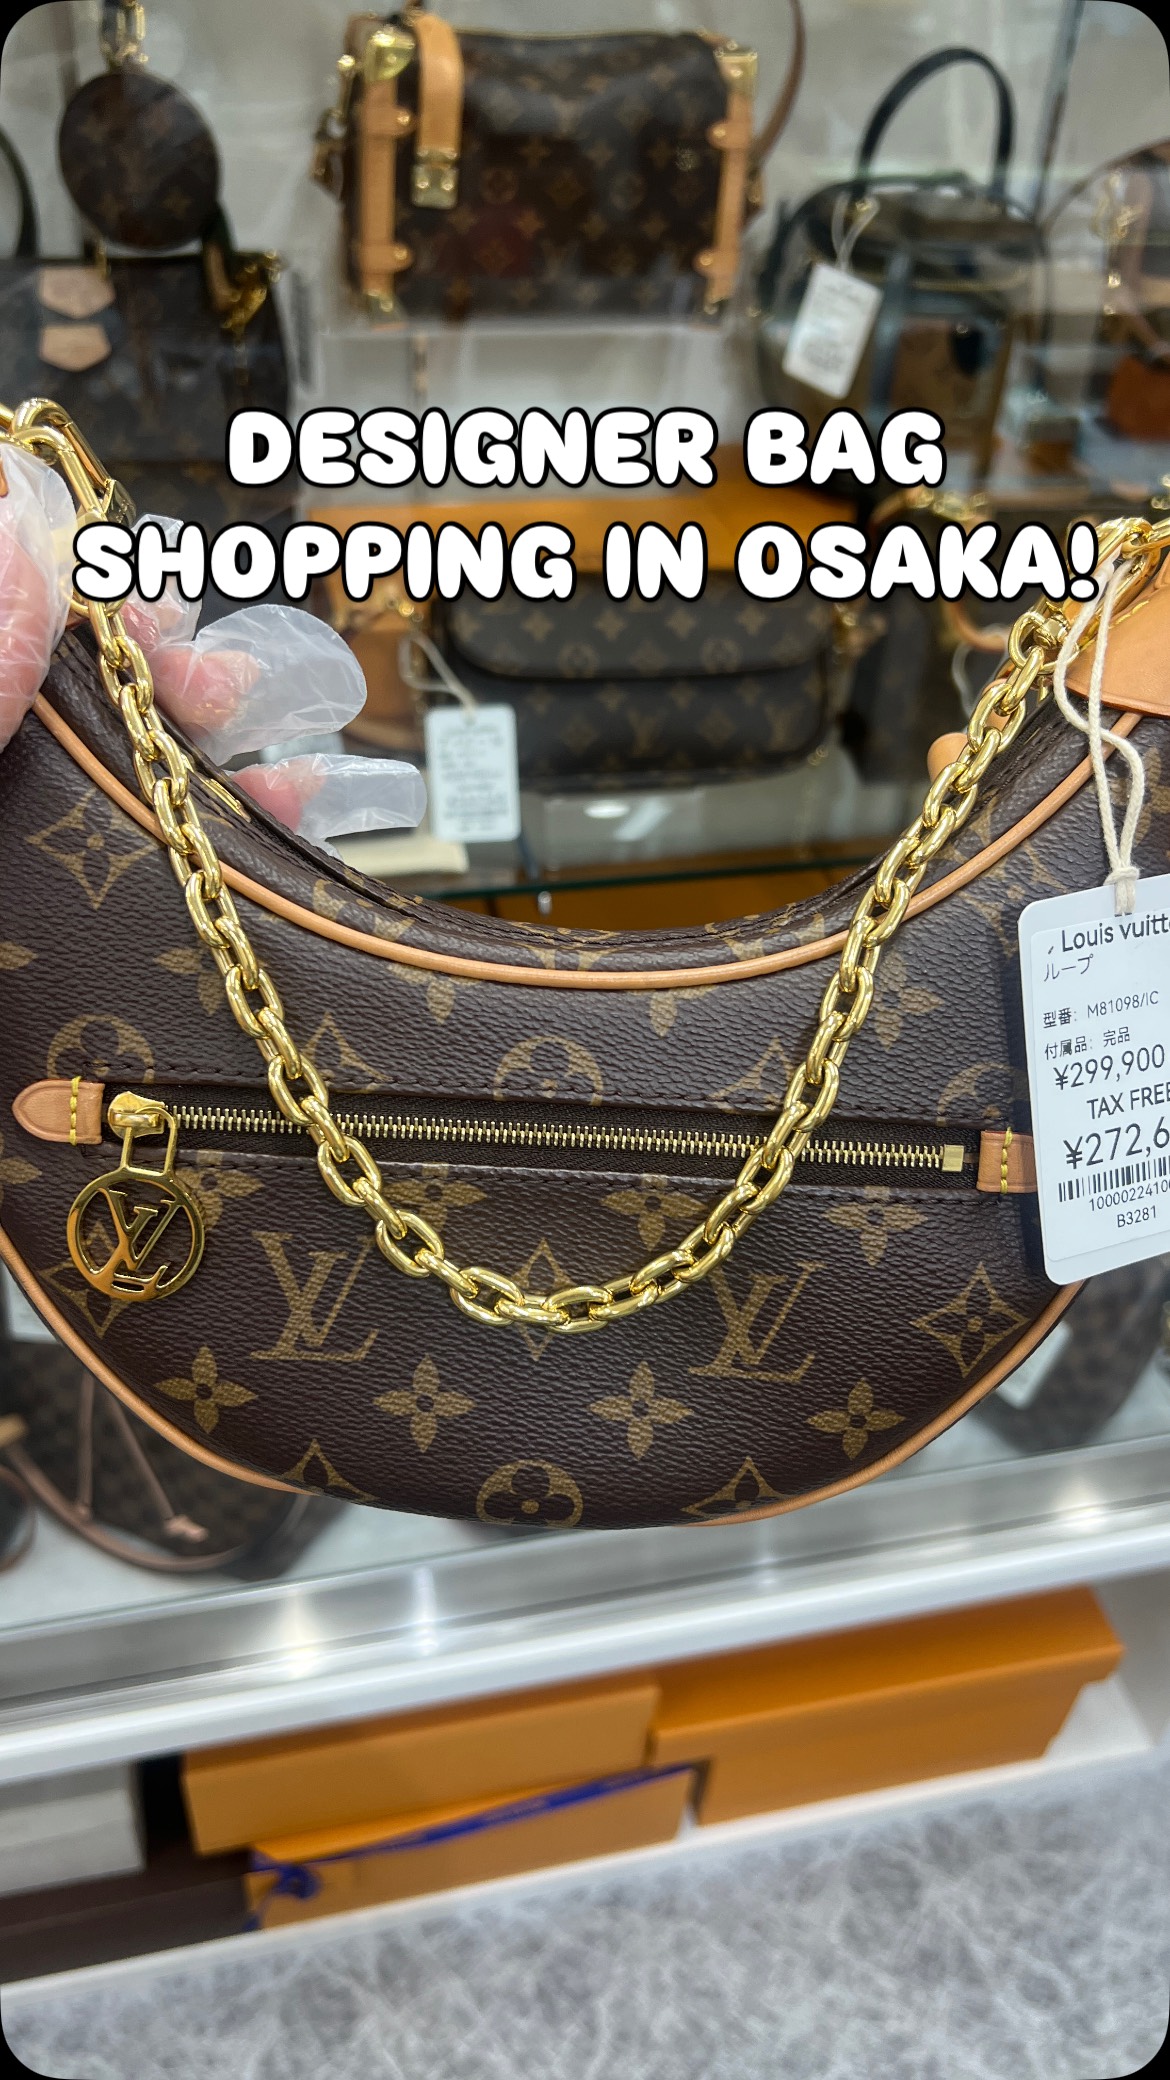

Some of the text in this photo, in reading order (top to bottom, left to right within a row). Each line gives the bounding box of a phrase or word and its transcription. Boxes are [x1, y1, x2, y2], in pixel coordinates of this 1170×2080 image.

[1061, 913, 1170, 953] Louis vuitt
[1043, 953, 1094, 982] ループ
[1103, 1026, 1130, 1047] 完品
[1053, 1044, 1165, 1090] ¥299,900
[1086, 1092, 1124, 1120] TAX
[1117, 1205, 1157, 1228] B3281
